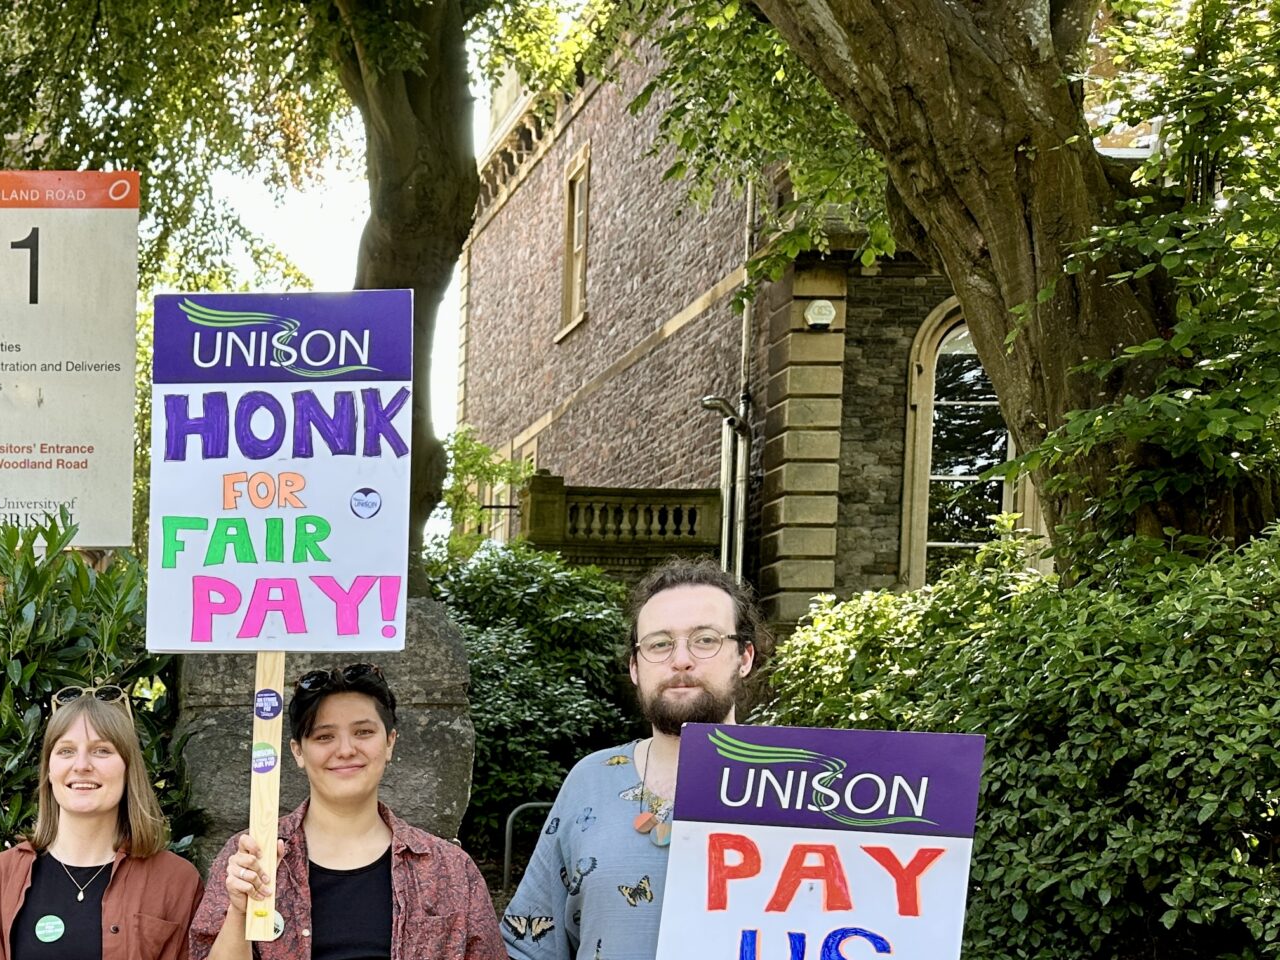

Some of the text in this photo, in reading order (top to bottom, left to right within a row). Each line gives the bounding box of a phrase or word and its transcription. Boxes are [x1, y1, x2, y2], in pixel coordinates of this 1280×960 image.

[45, 189, 86, 201] ROAD
[40, 361, 62, 372] and
[65, 361, 121, 372] Deliveries
[193, 329, 370, 368] UNISON
[163, 386, 411, 462] HONK
[40, 443, 95, 454] Entrance
[56, 459, 88, 469] Road
[63, 496, 78, 509] of
[223, 471, 307, 510] FOR
[162, 515, 332, 569] FAIR
[191, 575, 402, 642] PAY!
[719, 767, 929, 818] UNISON
[706, 832, 947, 917] PAY
